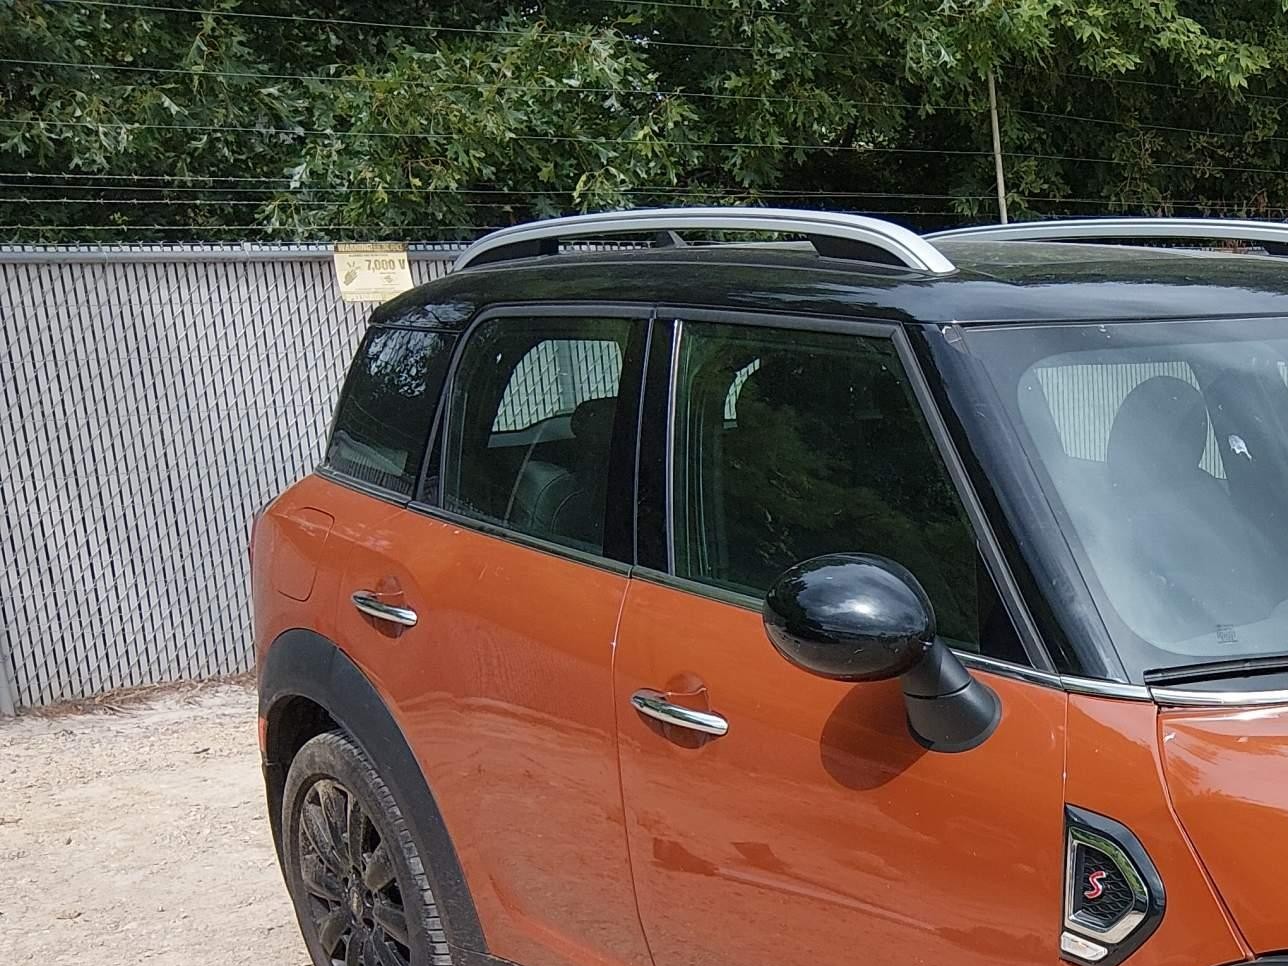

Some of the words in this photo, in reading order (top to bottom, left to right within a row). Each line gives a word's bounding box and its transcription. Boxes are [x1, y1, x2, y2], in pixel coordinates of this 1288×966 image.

[365, 259, 396, 272] 7,000
[399, 258, 406, 270] V
[1083, 870, 1107, 900] S
